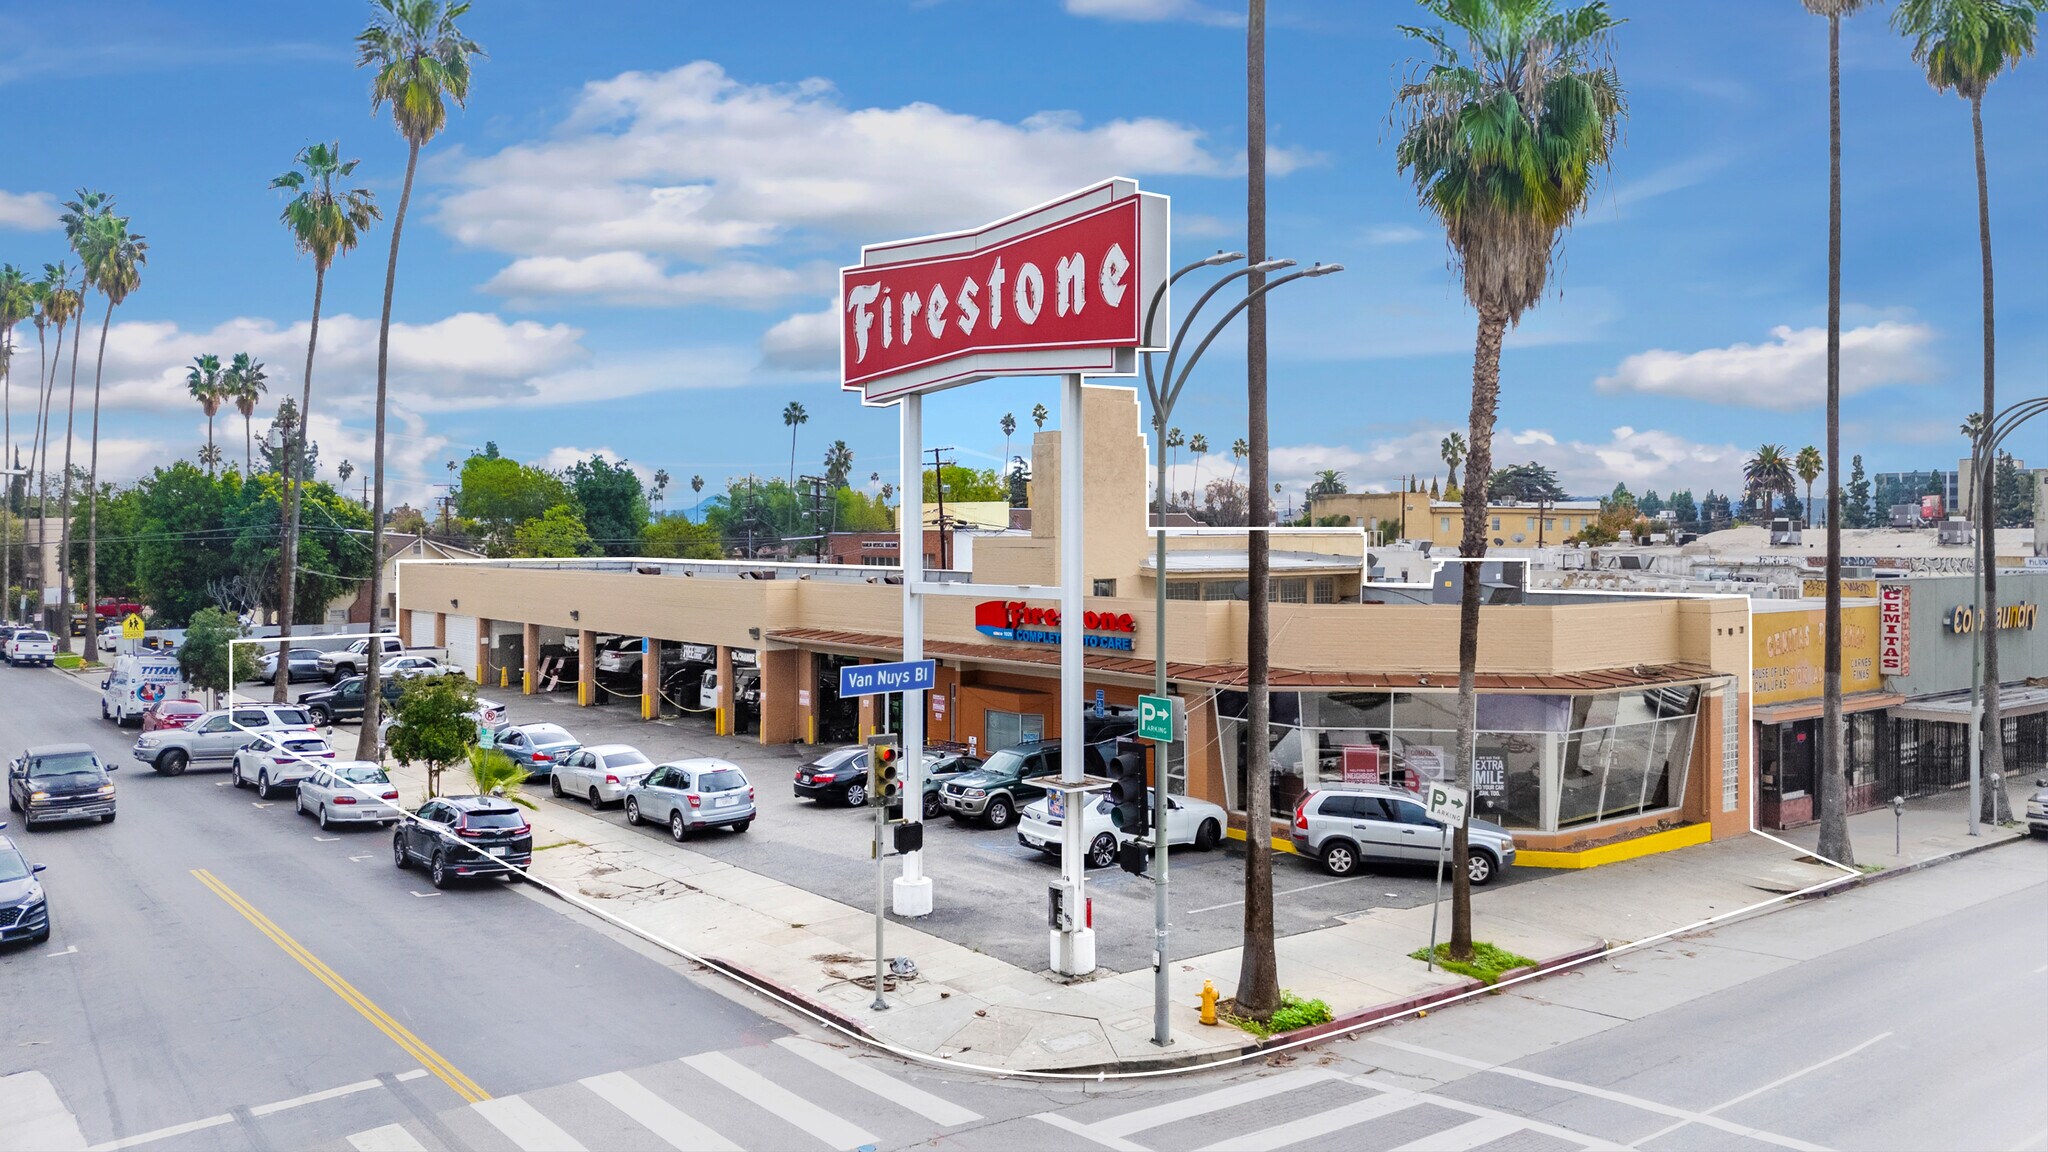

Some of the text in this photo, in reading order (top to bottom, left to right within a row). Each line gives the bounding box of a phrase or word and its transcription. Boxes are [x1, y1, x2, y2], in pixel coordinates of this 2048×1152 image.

[847, 242, 1131, 365] Firestone
[1008, 601, 1137, 633] Fireone
[1995, 600, 2039, 631] aundry
[1883, 591, 1900, 668] CEMITAS
[1016, 630, 1062, 645] COMPLET
[1099, 636, 1131, 650] CARE
[141, 666, 180, 675] TITAN
[848, 667, 928, 688] Van Nuys Bl
[1475, 760, 1504, 770] EXTRA
[1346, 772, 1377, 780] NEIGHBORS
[1475, 771, 1505, 785] MILE
